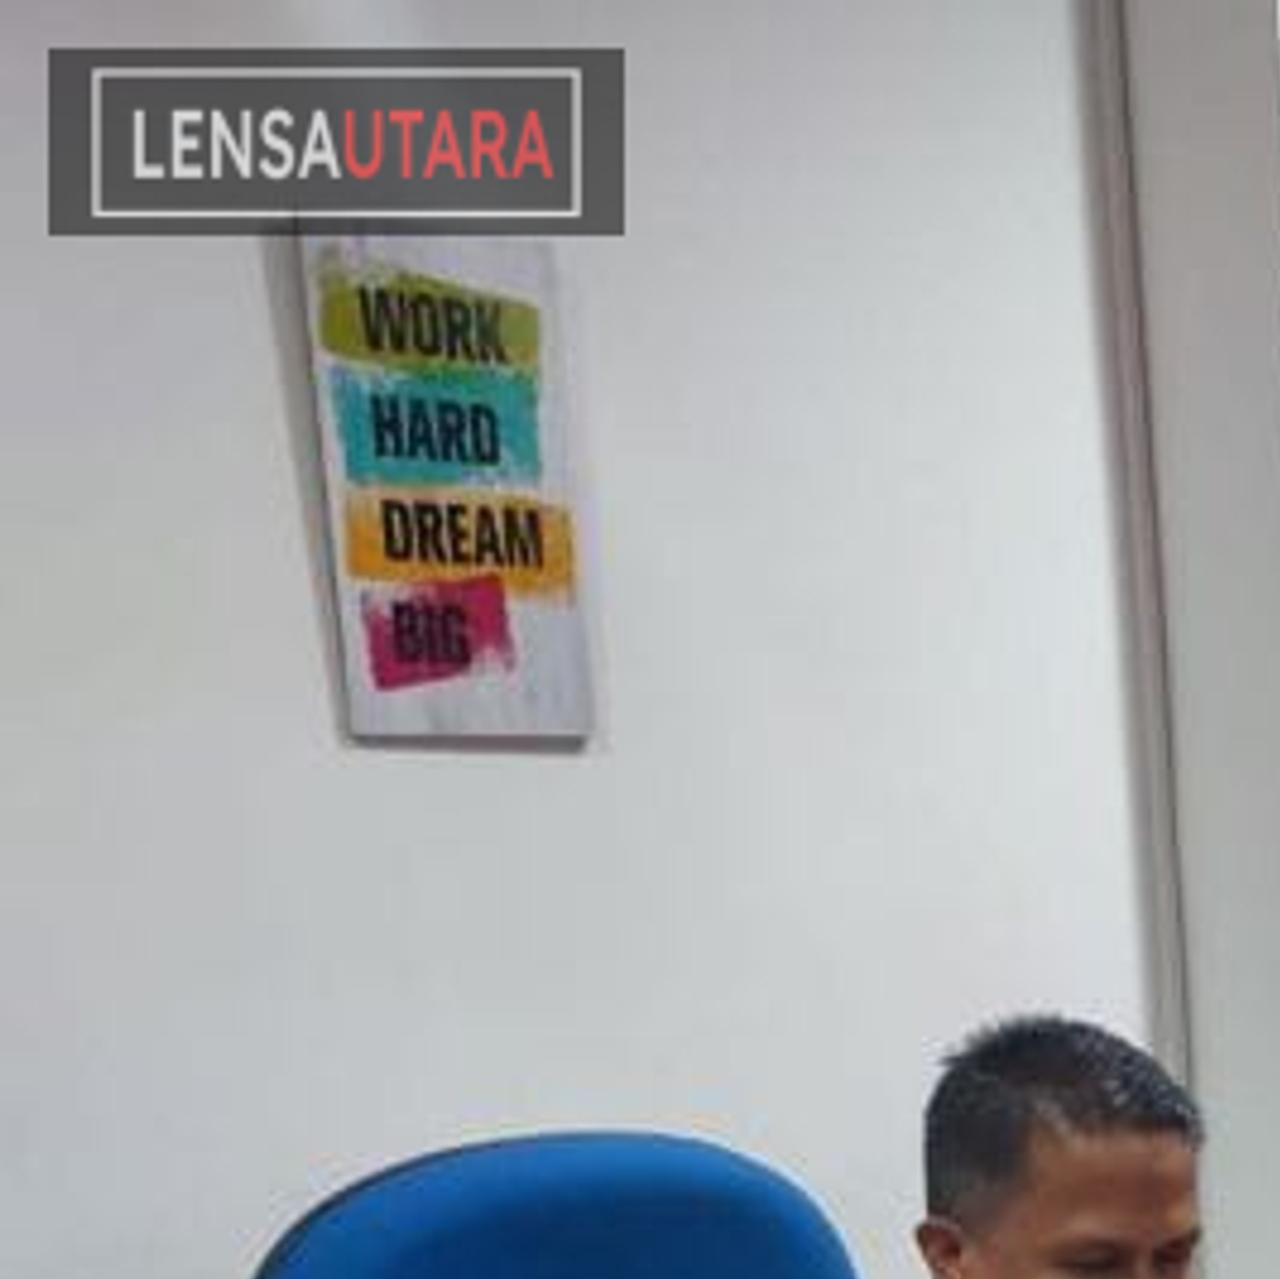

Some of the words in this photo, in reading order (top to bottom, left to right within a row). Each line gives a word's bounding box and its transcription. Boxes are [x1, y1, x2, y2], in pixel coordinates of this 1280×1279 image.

[360, 286, 508, 364] WORK
[372, 395, 500, 465] HARD
[382, 499, 544, 568] DREAM
[391, 600, 471, 667] BIG
